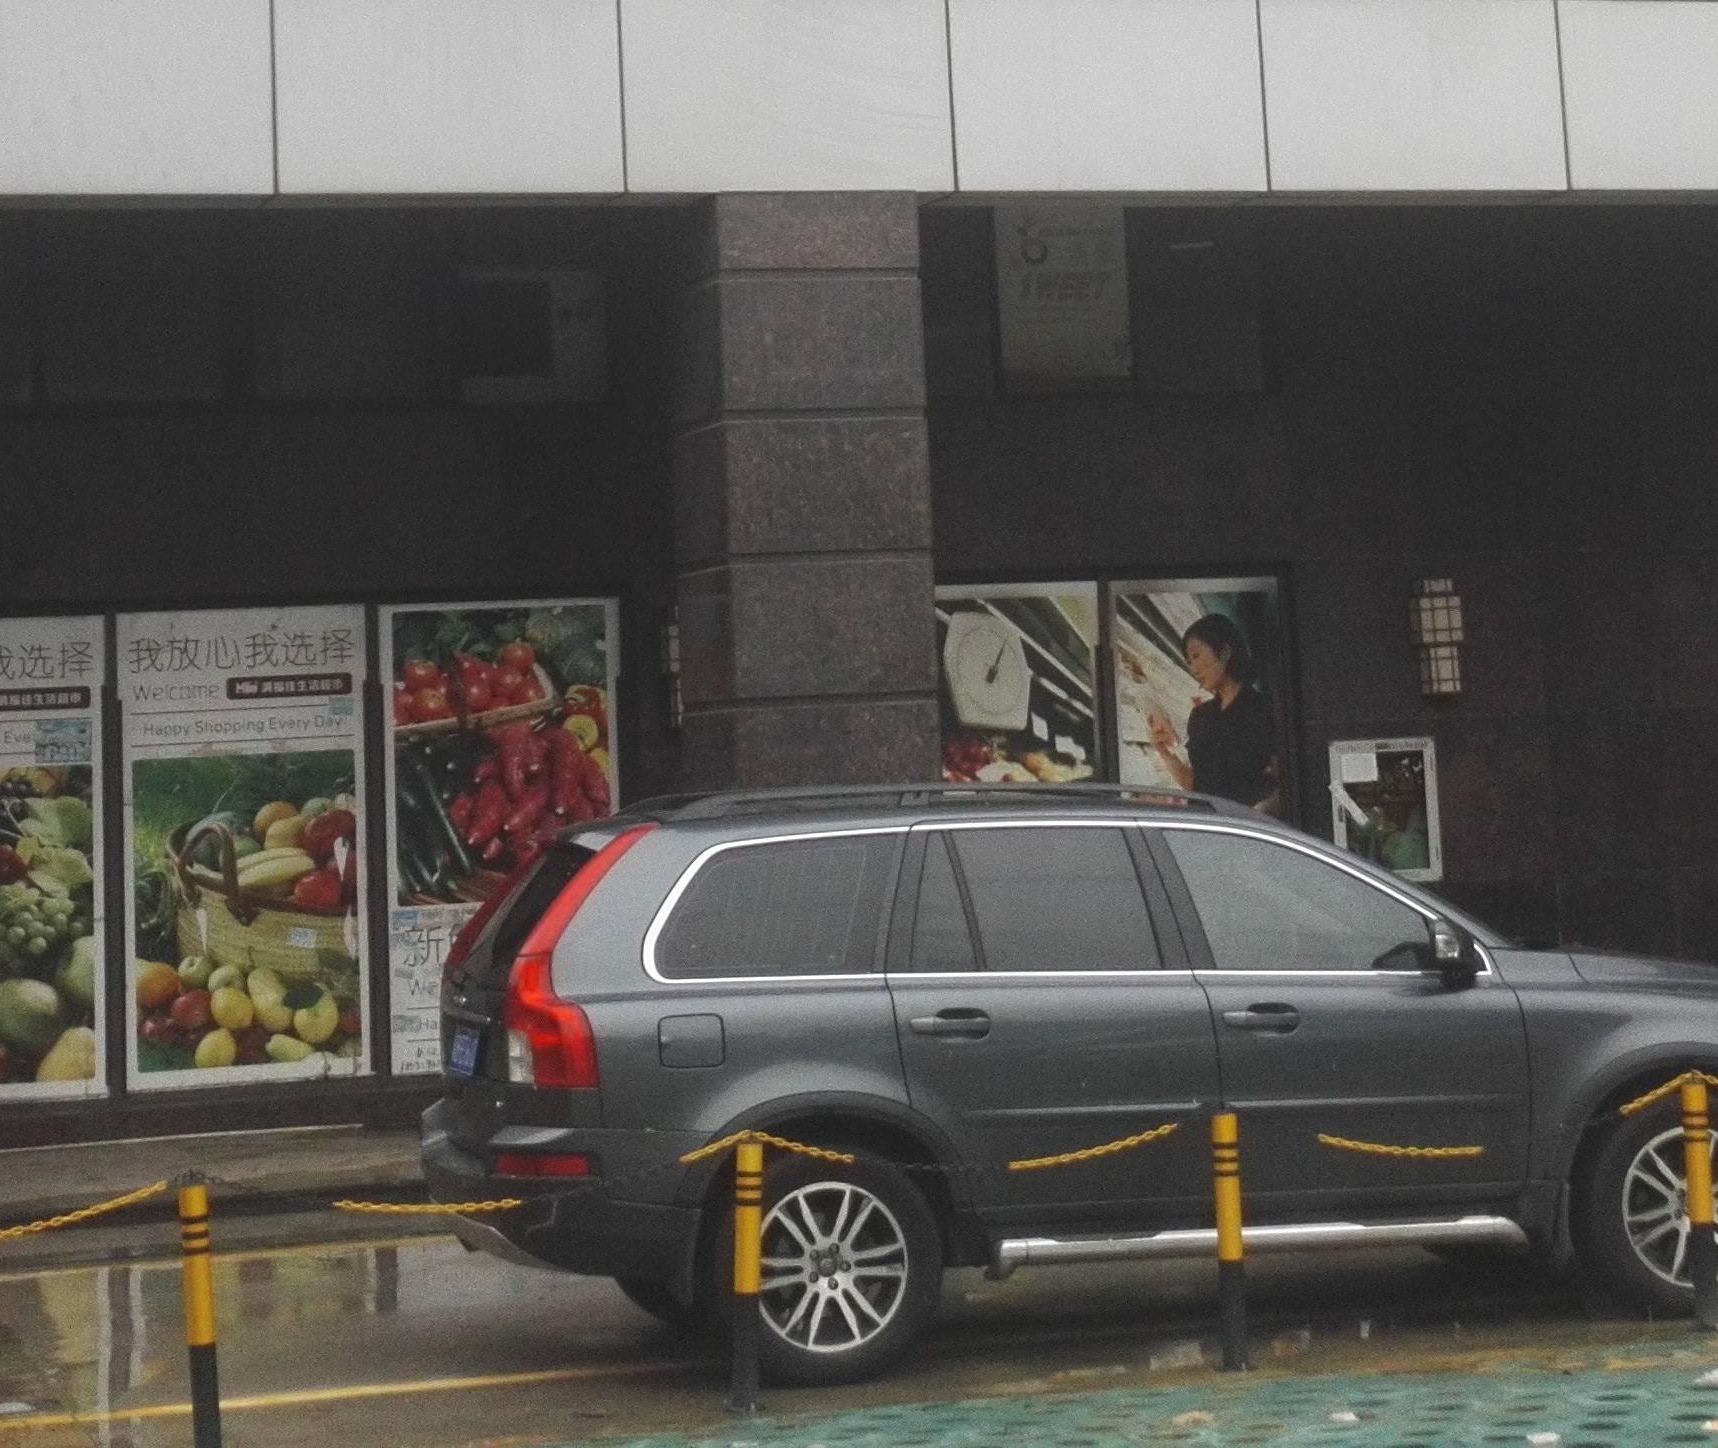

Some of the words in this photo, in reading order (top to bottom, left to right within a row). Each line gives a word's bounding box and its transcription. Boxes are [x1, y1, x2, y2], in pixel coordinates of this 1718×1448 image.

[132, 683, 220, 702] Welcome
[143, 723, 190, 738] Happy
[194, 718, 265, 734] Shopping
[268, 715, 311, 731] Every
[314, 713, 344, 728] Day
